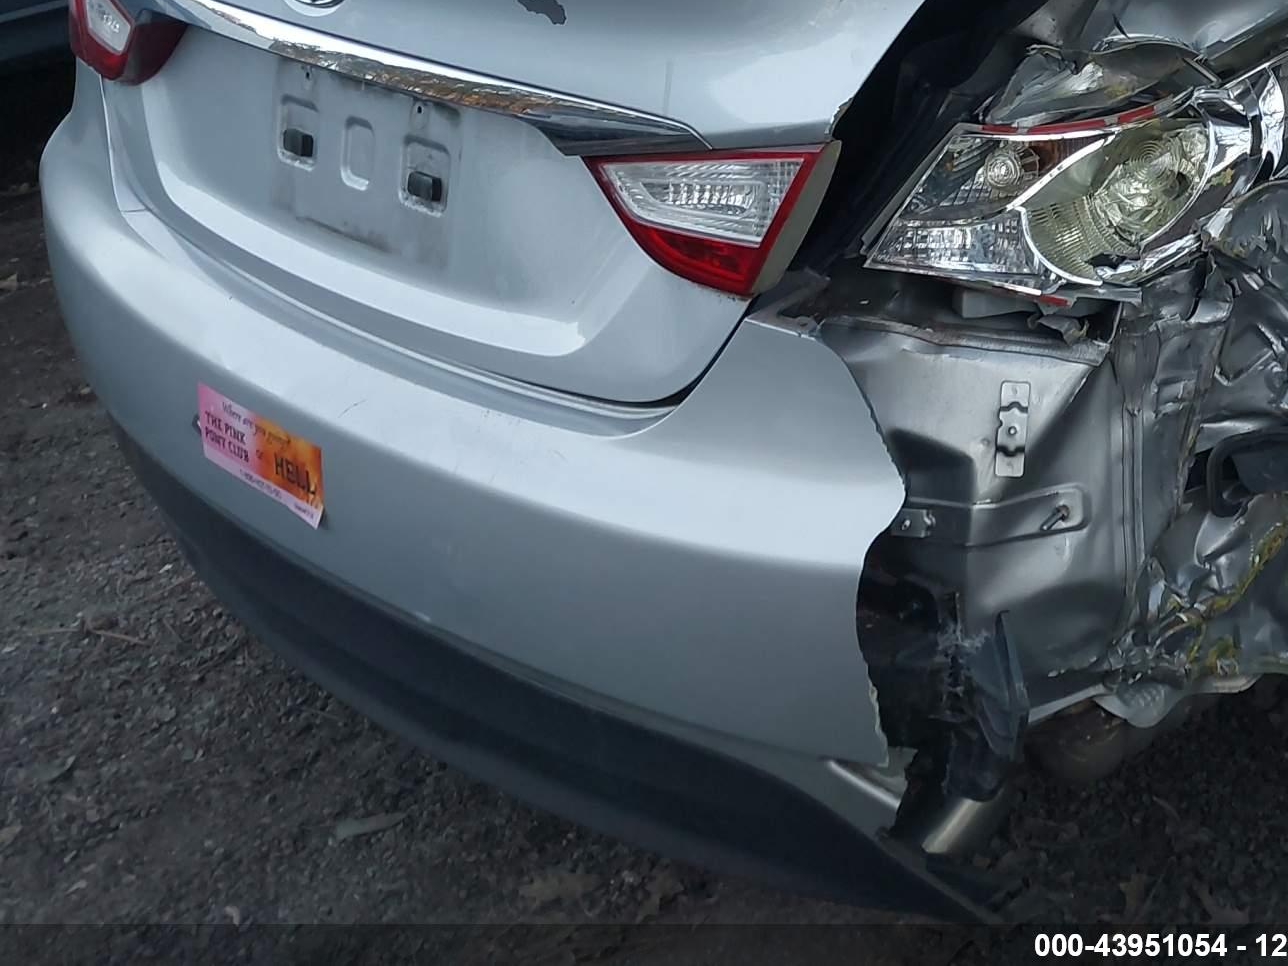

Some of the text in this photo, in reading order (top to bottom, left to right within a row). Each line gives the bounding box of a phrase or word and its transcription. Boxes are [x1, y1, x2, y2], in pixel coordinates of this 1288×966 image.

[205, 410, 246, 445] THE PINK
[205, 426, 249, 463] PONY CLUB
[274, 451, 316, 496] HELL
